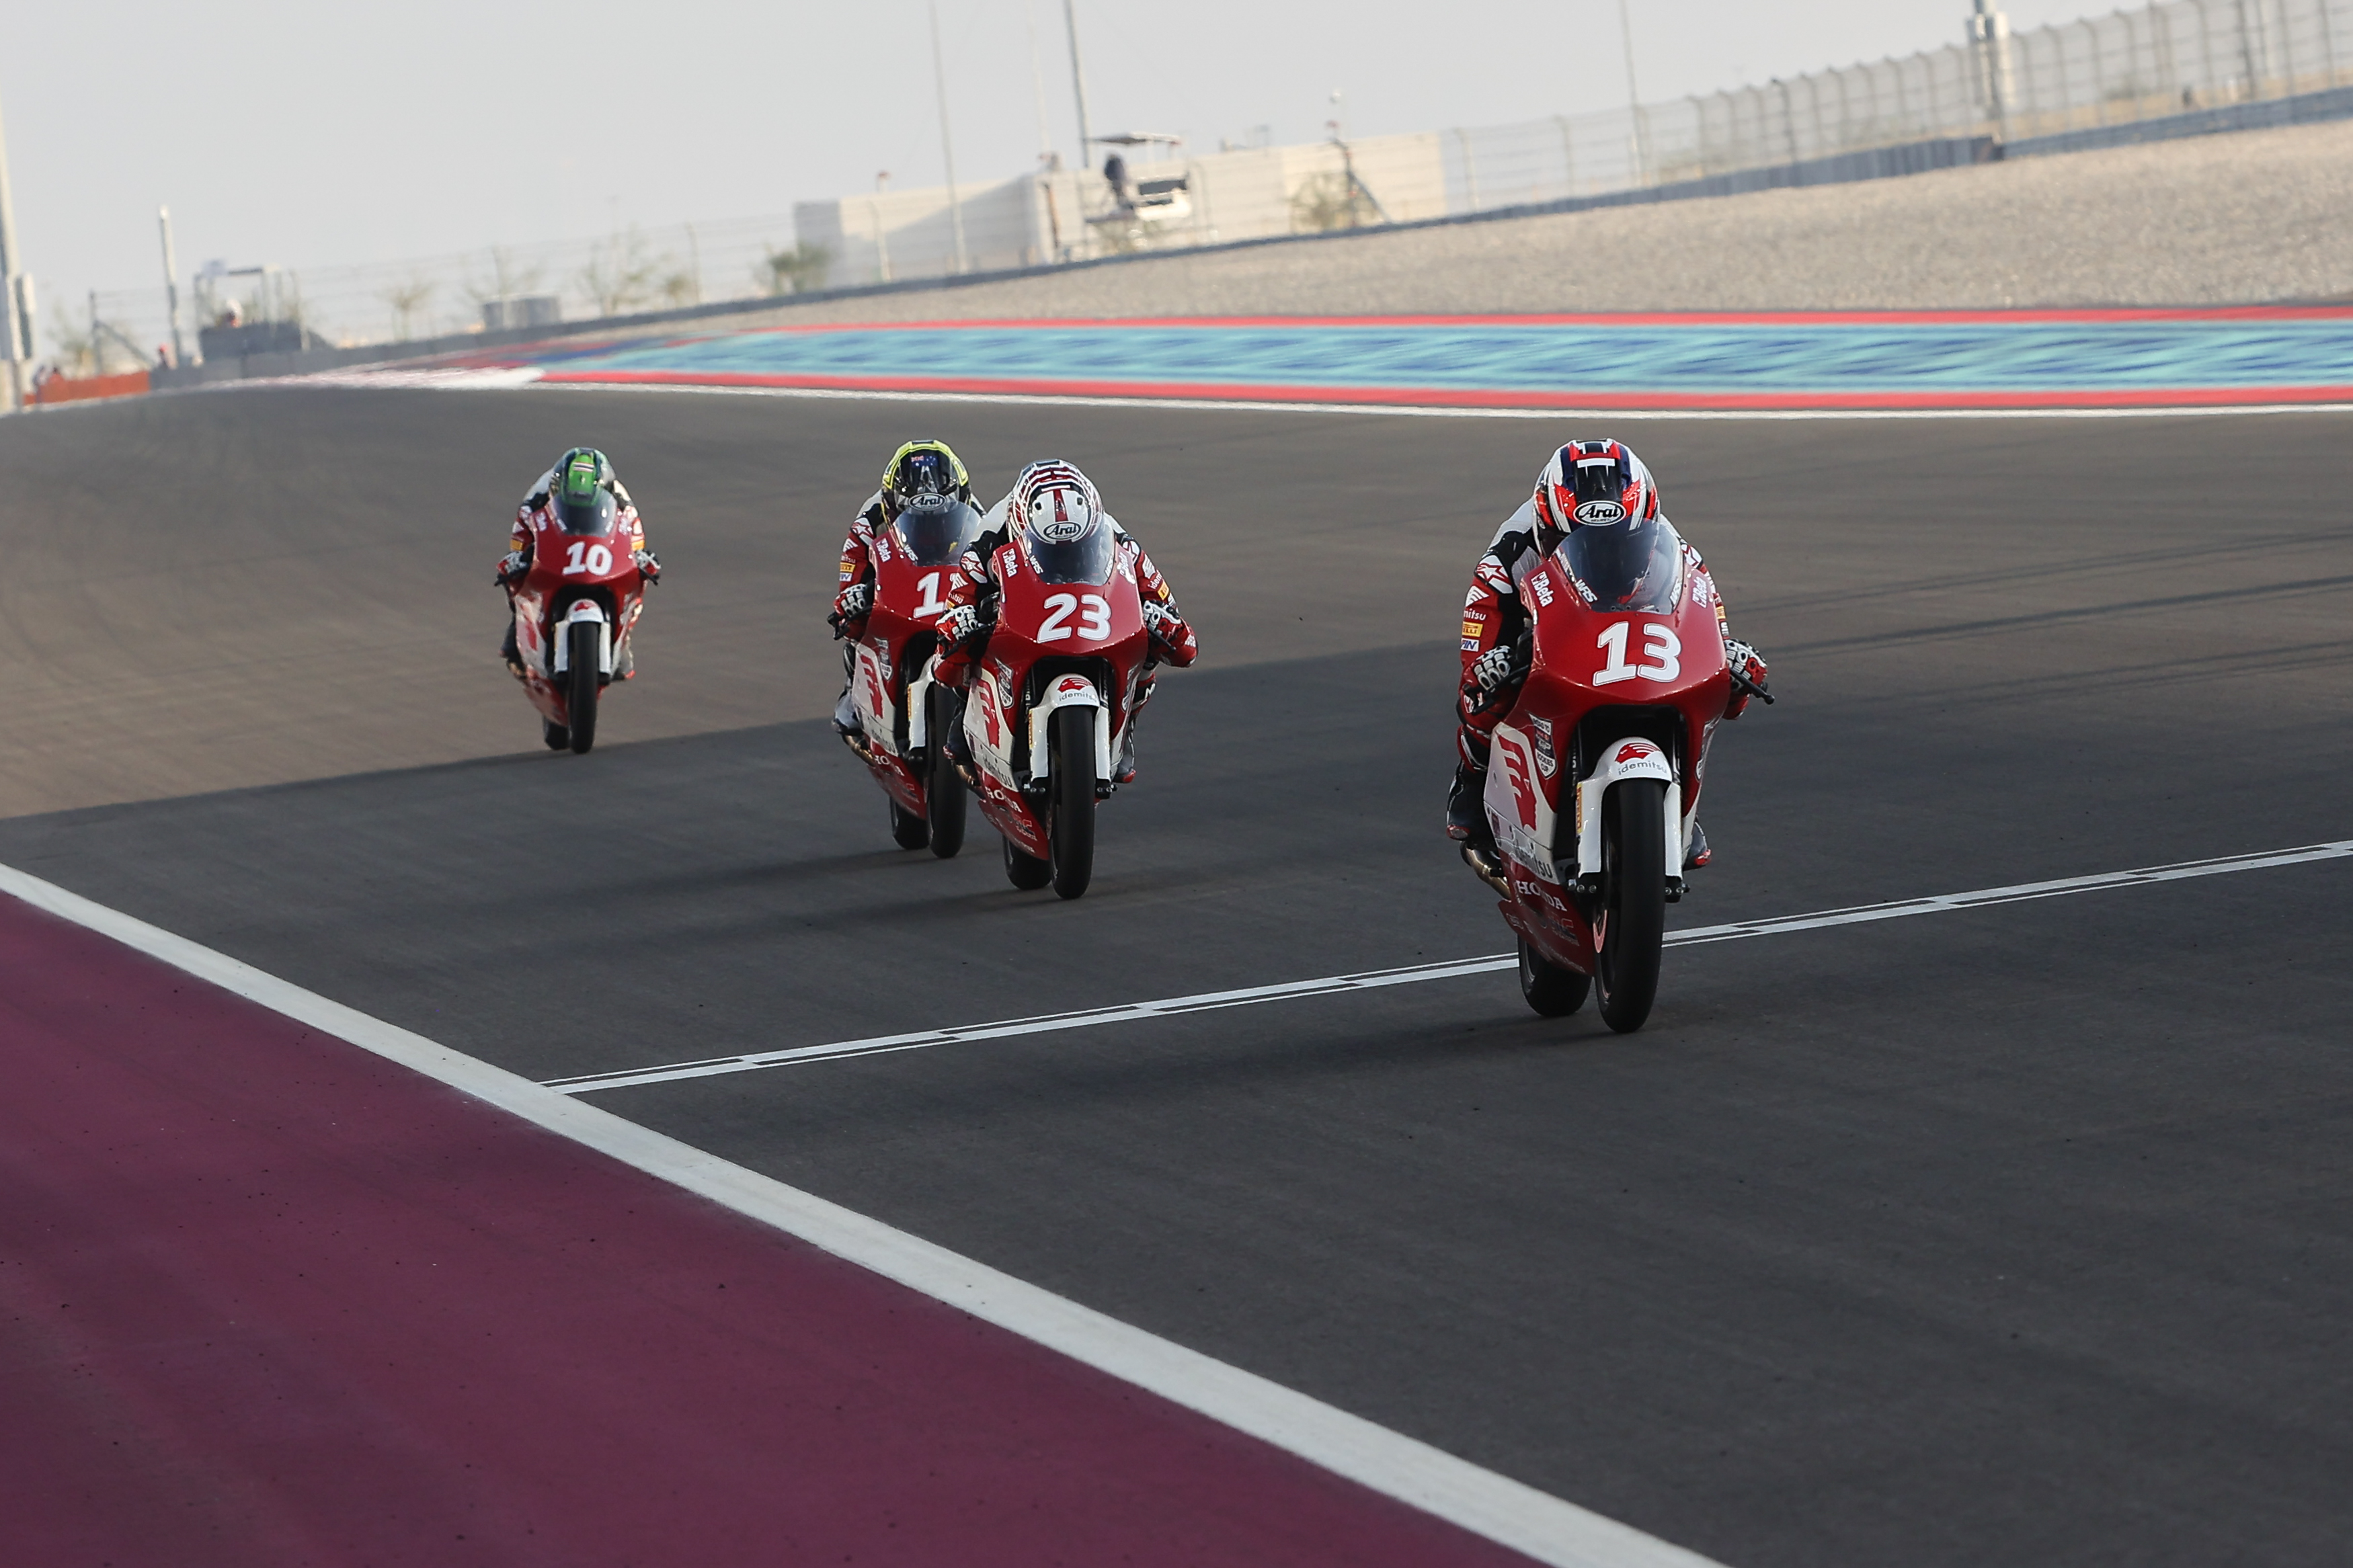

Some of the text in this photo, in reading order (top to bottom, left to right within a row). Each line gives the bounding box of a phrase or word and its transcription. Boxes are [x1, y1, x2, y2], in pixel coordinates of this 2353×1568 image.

[1579, 505, 1619, 518] Arai
[1047, 524, 1076, 535] Arai
[563, 541, 612, 576] 10
[1004, 554, 1019, 578] Beta
[914, 571, 957, 618] 1
[1533, 579, 1554, 607] Beta
[1037, 593, 1112, 644] 23
[1593, 621, 1681, 686] 13
[1618, 760, 1667, 775] idemitsu
